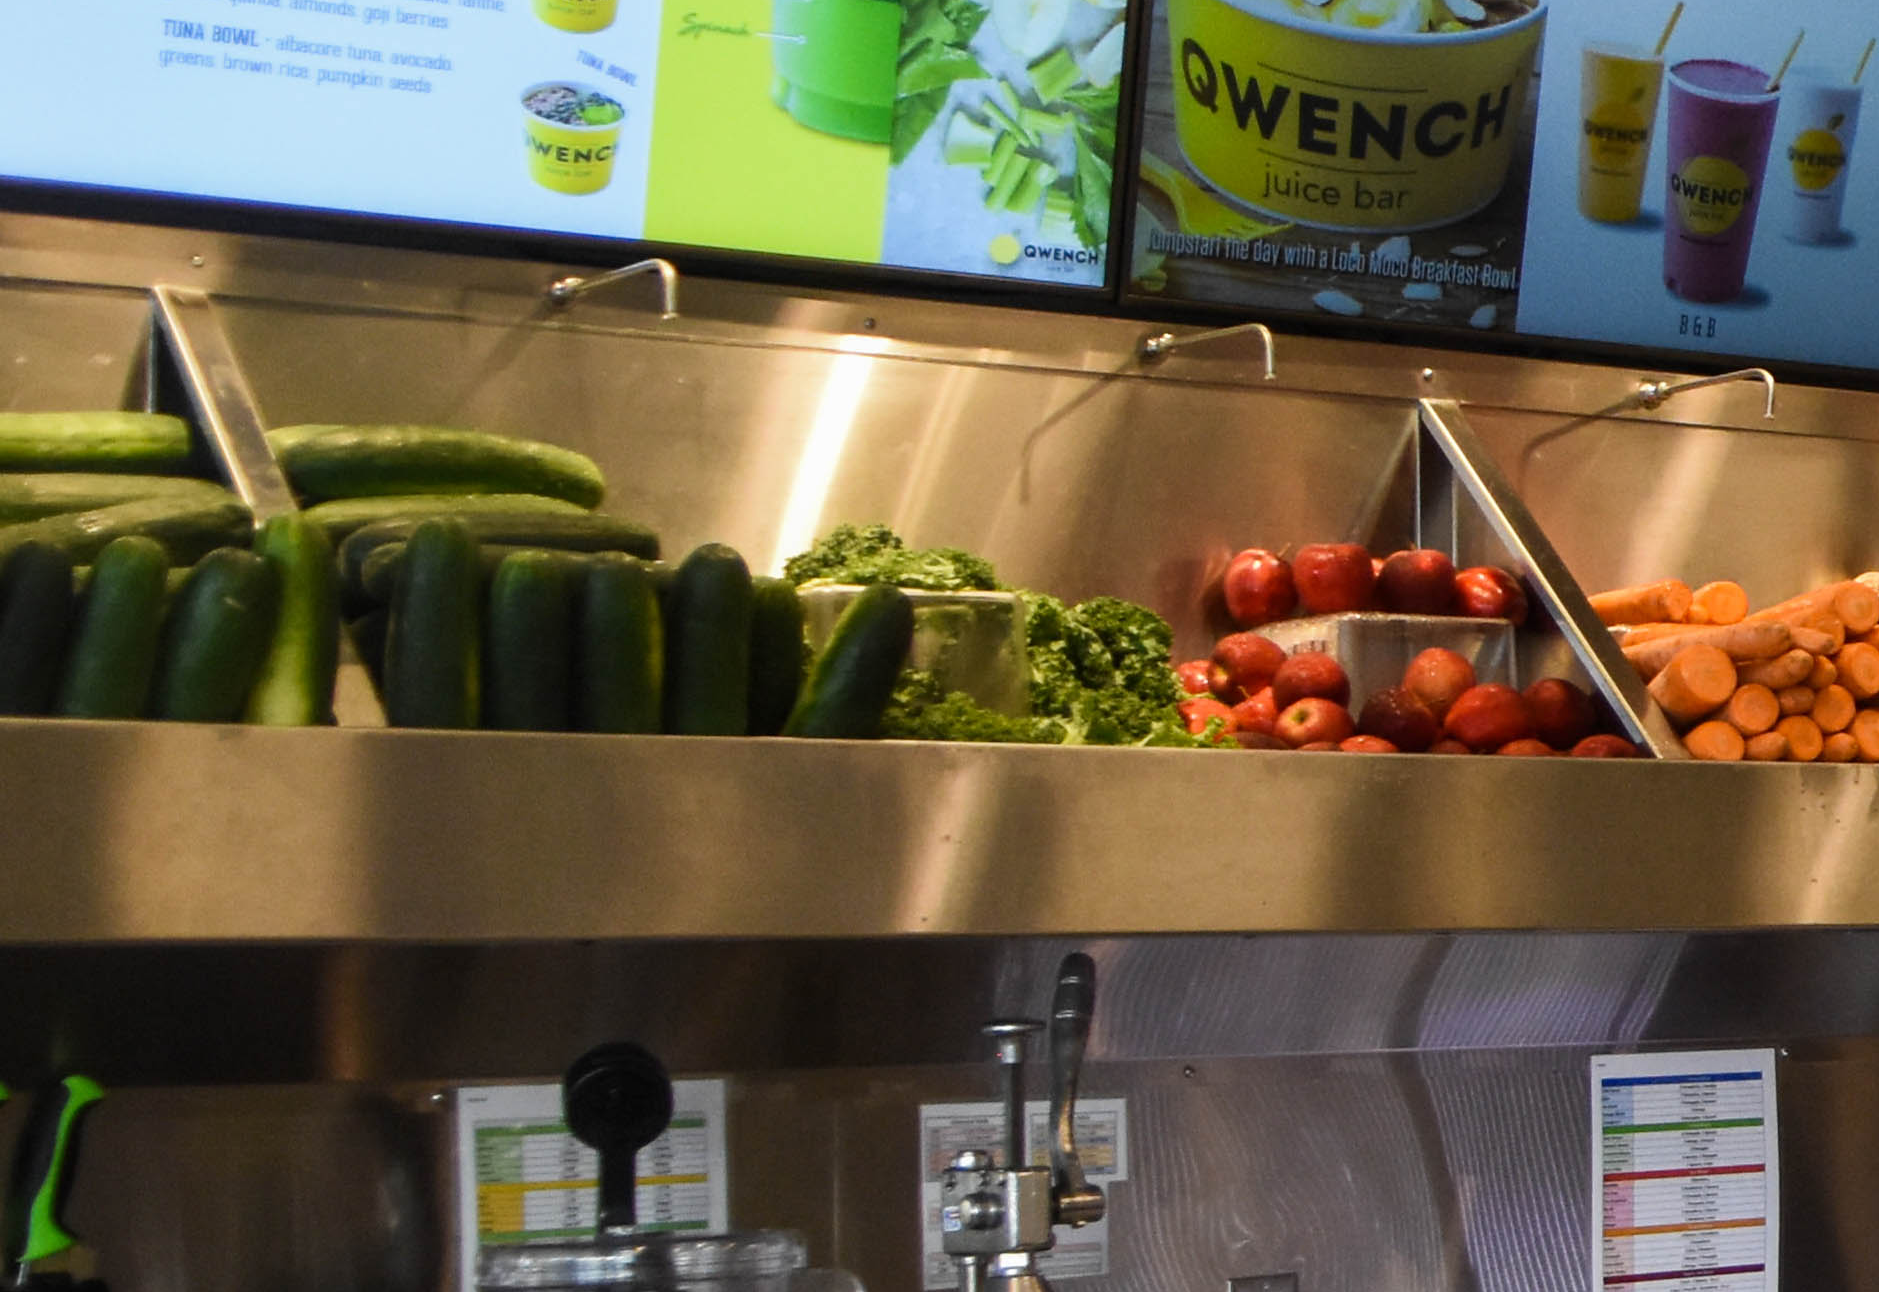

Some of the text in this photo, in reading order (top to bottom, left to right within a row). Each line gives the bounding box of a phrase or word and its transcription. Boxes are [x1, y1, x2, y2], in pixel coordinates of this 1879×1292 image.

[160, 18, 260, 48] TUNA BOWL
[1180, 37, 1514, 162] QWENCH
[1261, 163, 1411, 213] juice bar
[1671, 171, 1753, 208] QWENCH
[1023, 243, 1100, 268] QWENCH
[1223, 239, 1249, 261] the
[1252, 241, 1282, 267] day
[1283, 244, 1317, 269] with
[1319, 250, 1329, 269] a
[1411, 255, 1480, 286] Breakfast
[1677, 312, 1718, 339] B & B
